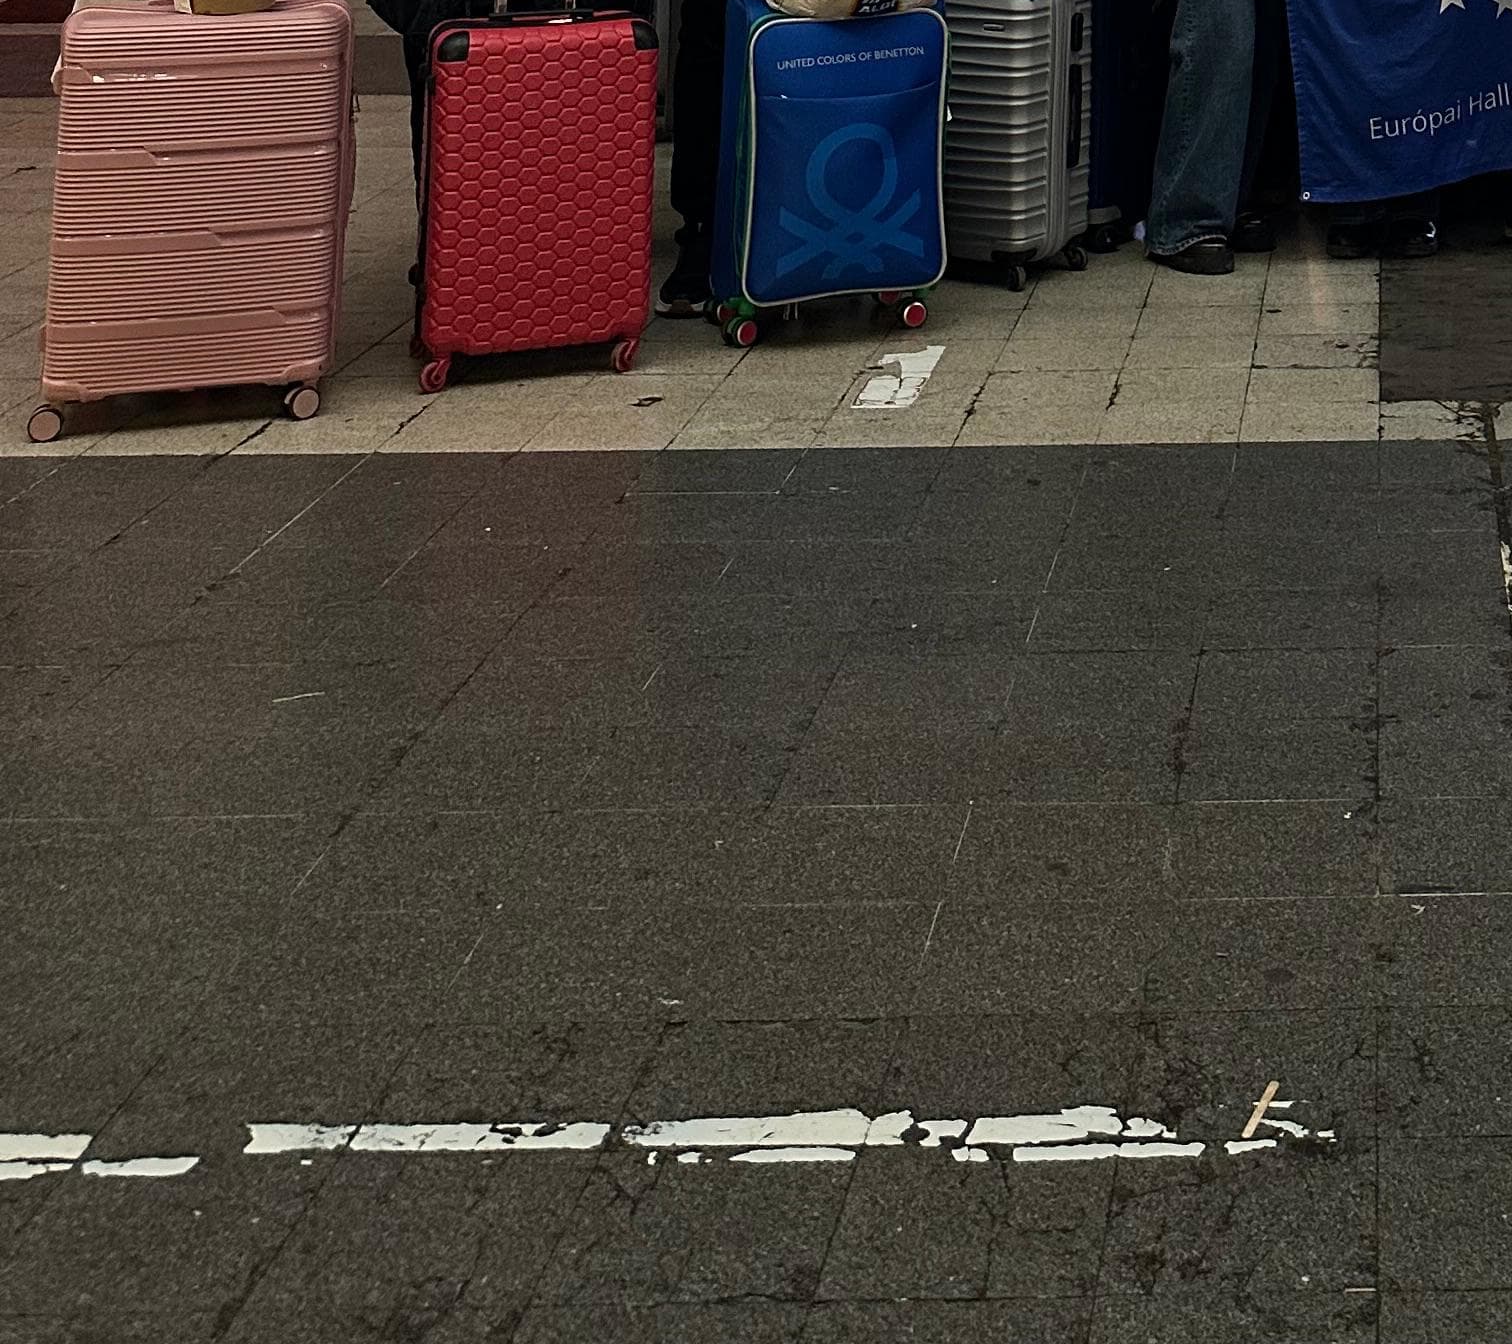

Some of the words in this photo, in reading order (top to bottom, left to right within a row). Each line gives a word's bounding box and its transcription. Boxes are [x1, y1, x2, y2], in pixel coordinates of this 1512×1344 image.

[776, 57, 815, 70] UNITED
[817, 53, 856, 66] COLORS
[858, 51, 873, 61] OF
[874, 46, 925, 60] BENETTON
[1369, 100, 1461, 140] Európai
